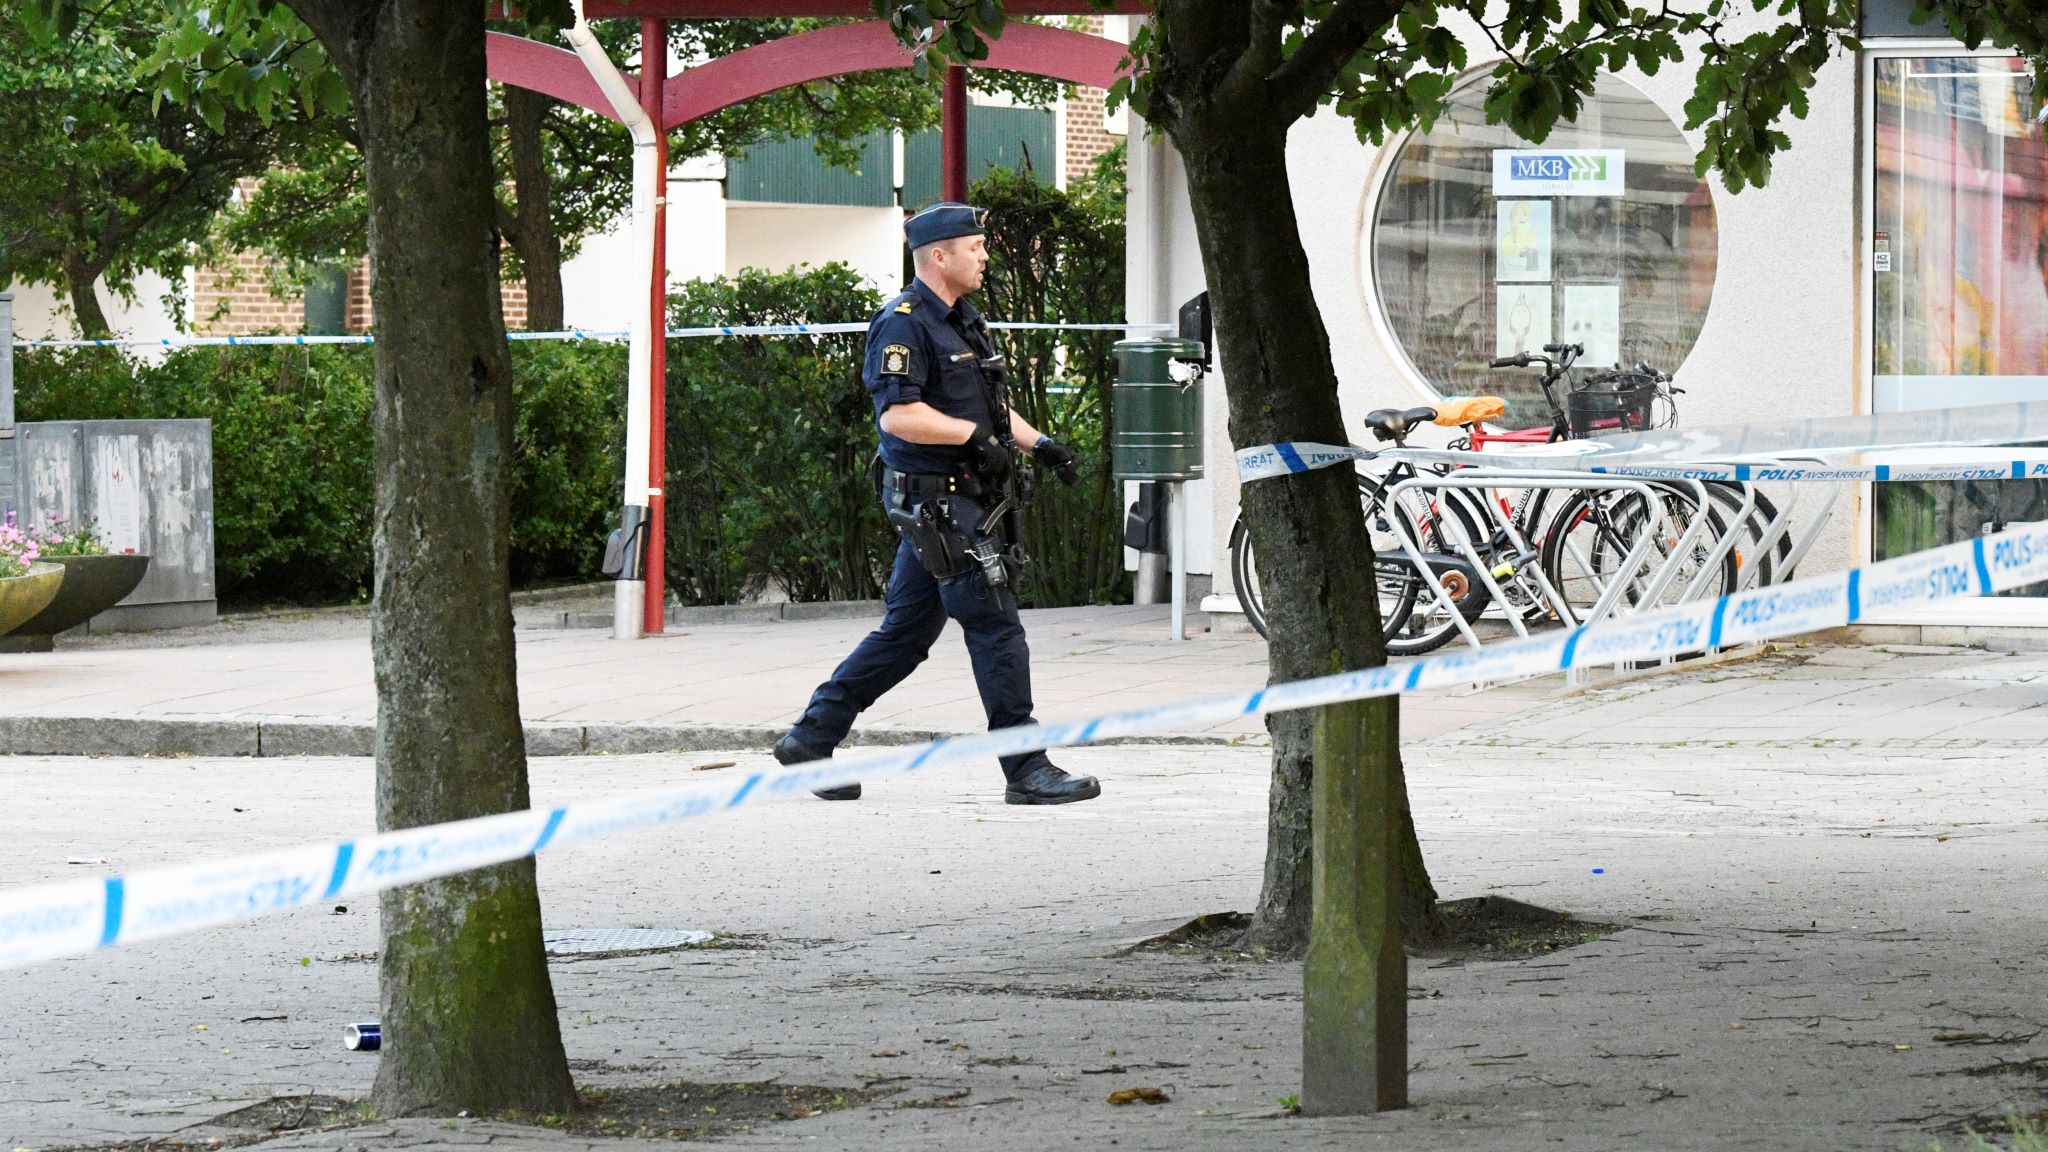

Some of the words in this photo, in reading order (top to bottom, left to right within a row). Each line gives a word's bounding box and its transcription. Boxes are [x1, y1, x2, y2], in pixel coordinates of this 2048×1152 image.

[1517, 159, 1564, 177] MKB
[884, 346, 908, 355] POLIS
[1756, 469, 1806, 480] POLIS
[1803, 469, 1872, 479] AVSPÄRRAT
[1962, 469, 2006, 479] POLIS
